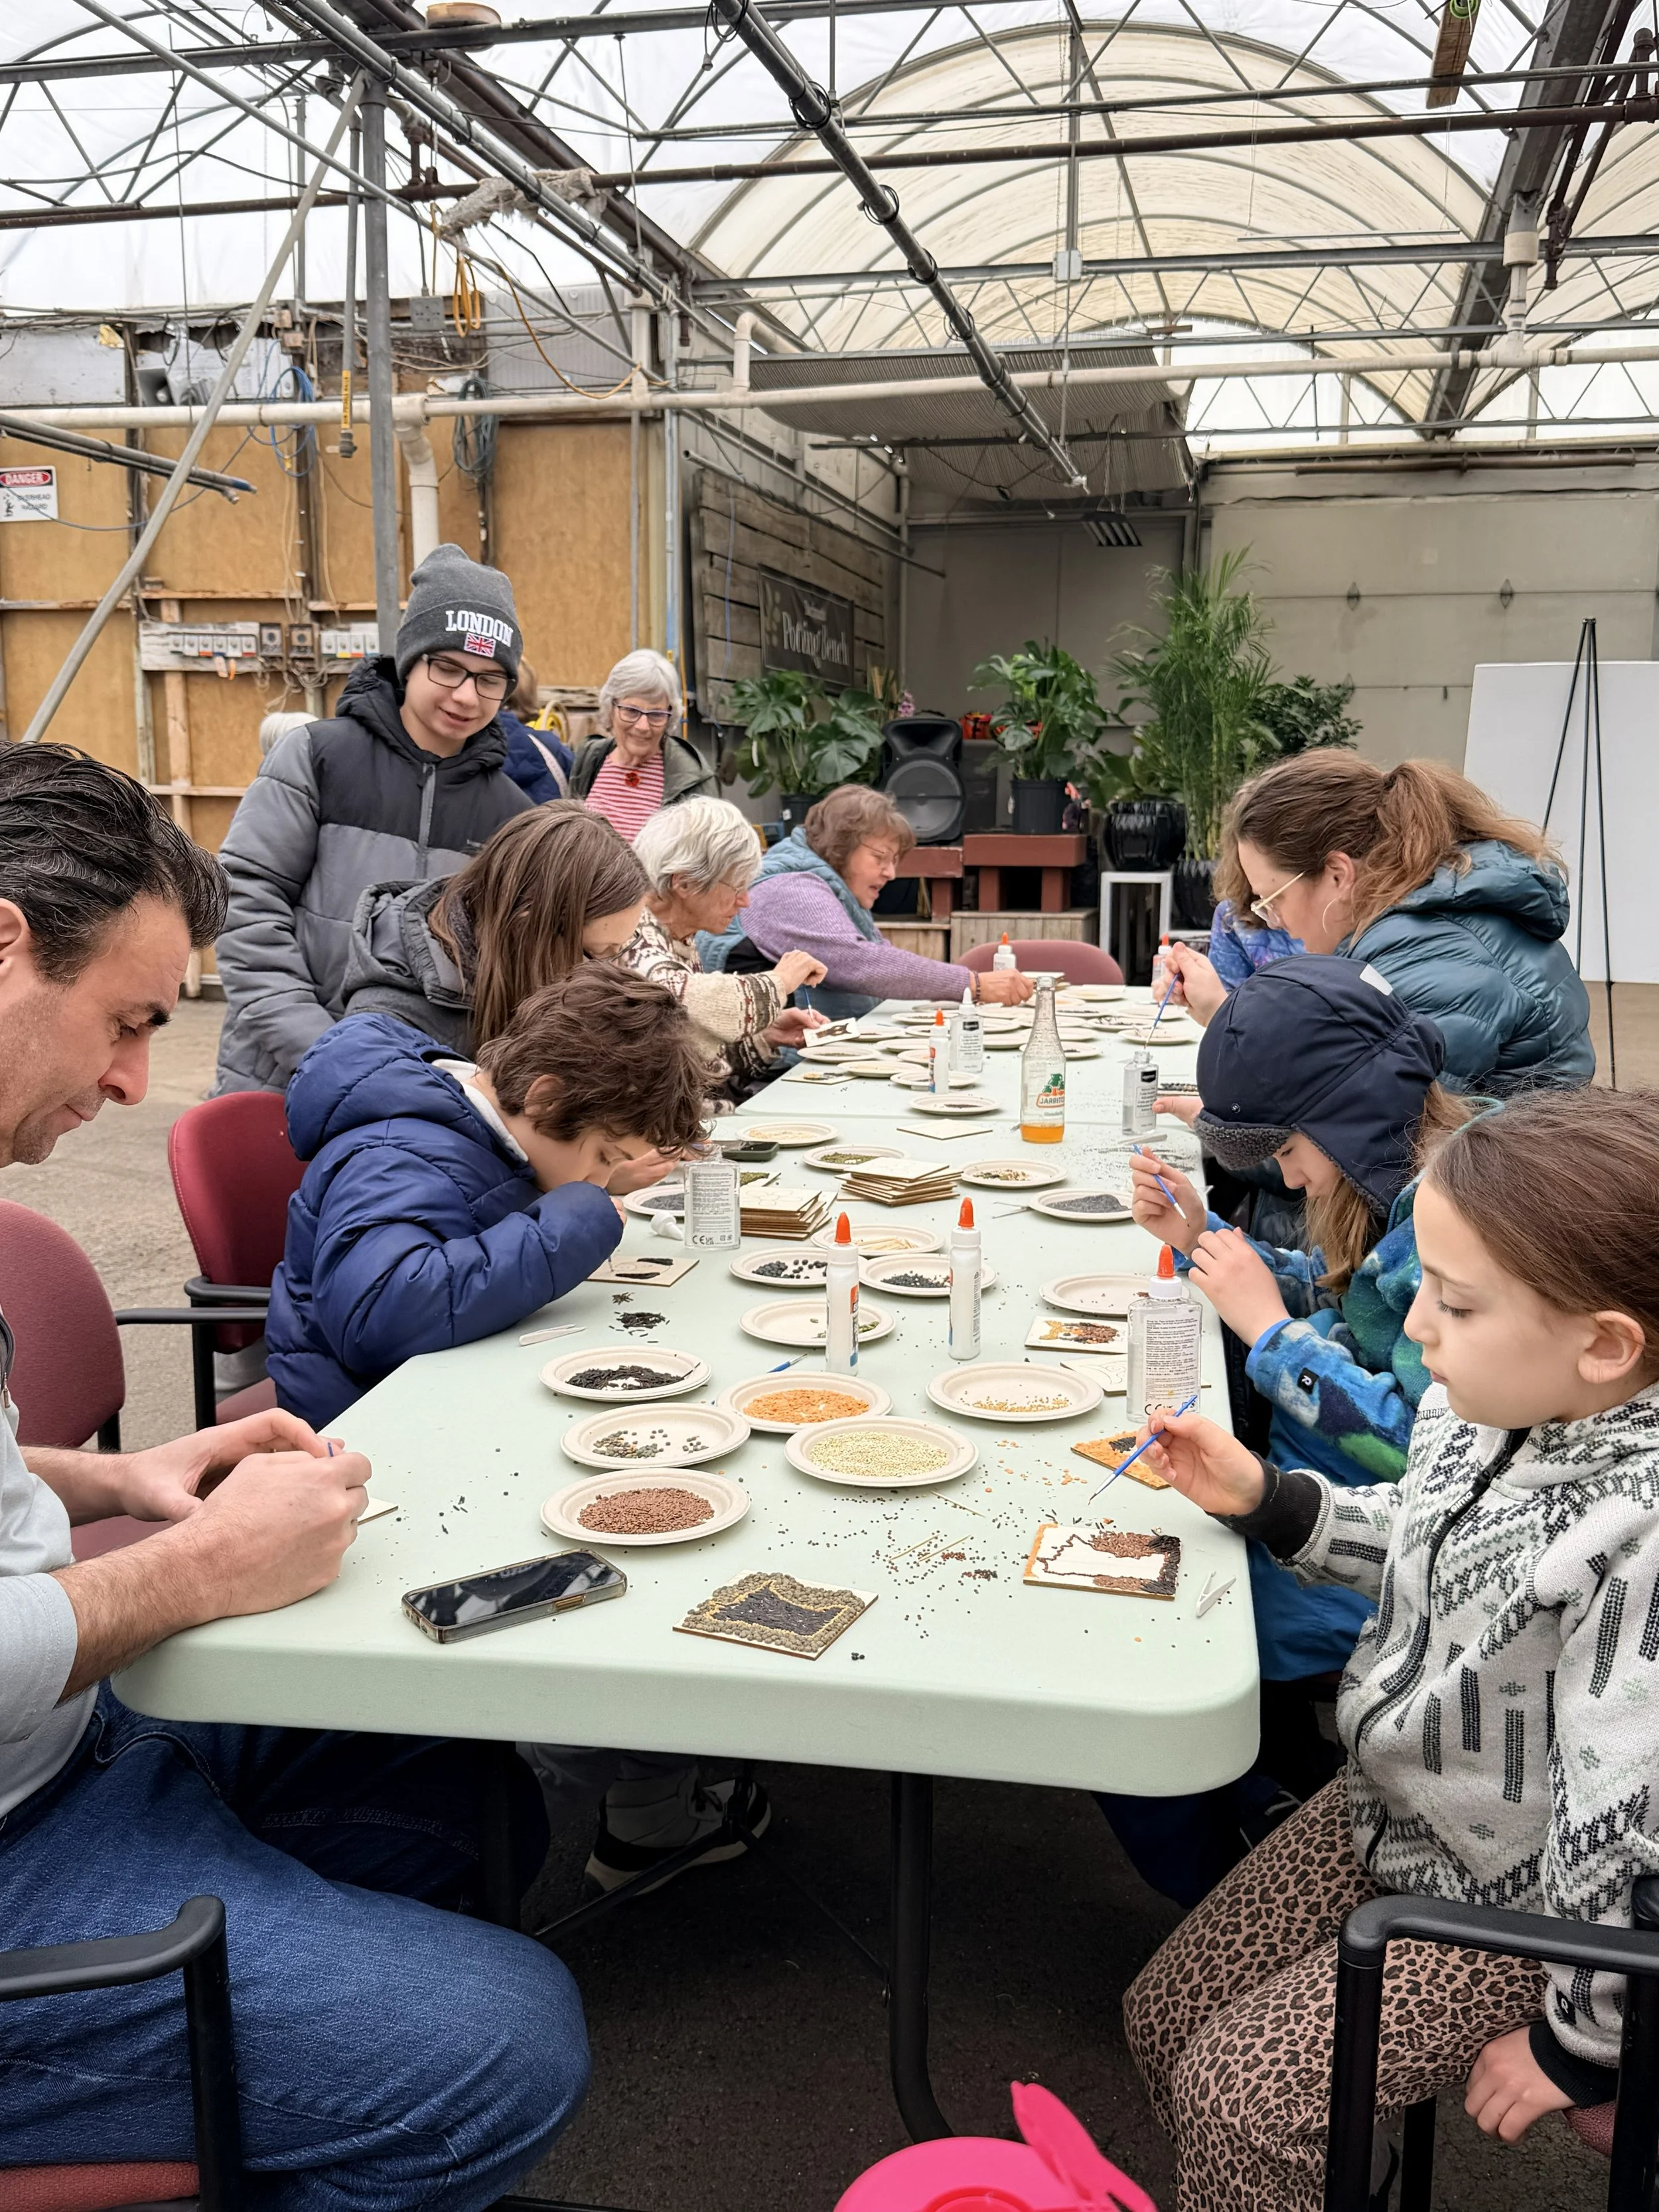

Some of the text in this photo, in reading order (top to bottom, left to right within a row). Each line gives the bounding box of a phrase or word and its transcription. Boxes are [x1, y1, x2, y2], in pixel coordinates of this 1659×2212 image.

[5, 472, 43, 486] DANGER
[445, 611, 514, 648] LONDON
[782, 611, 850, 670] Potting Bench
